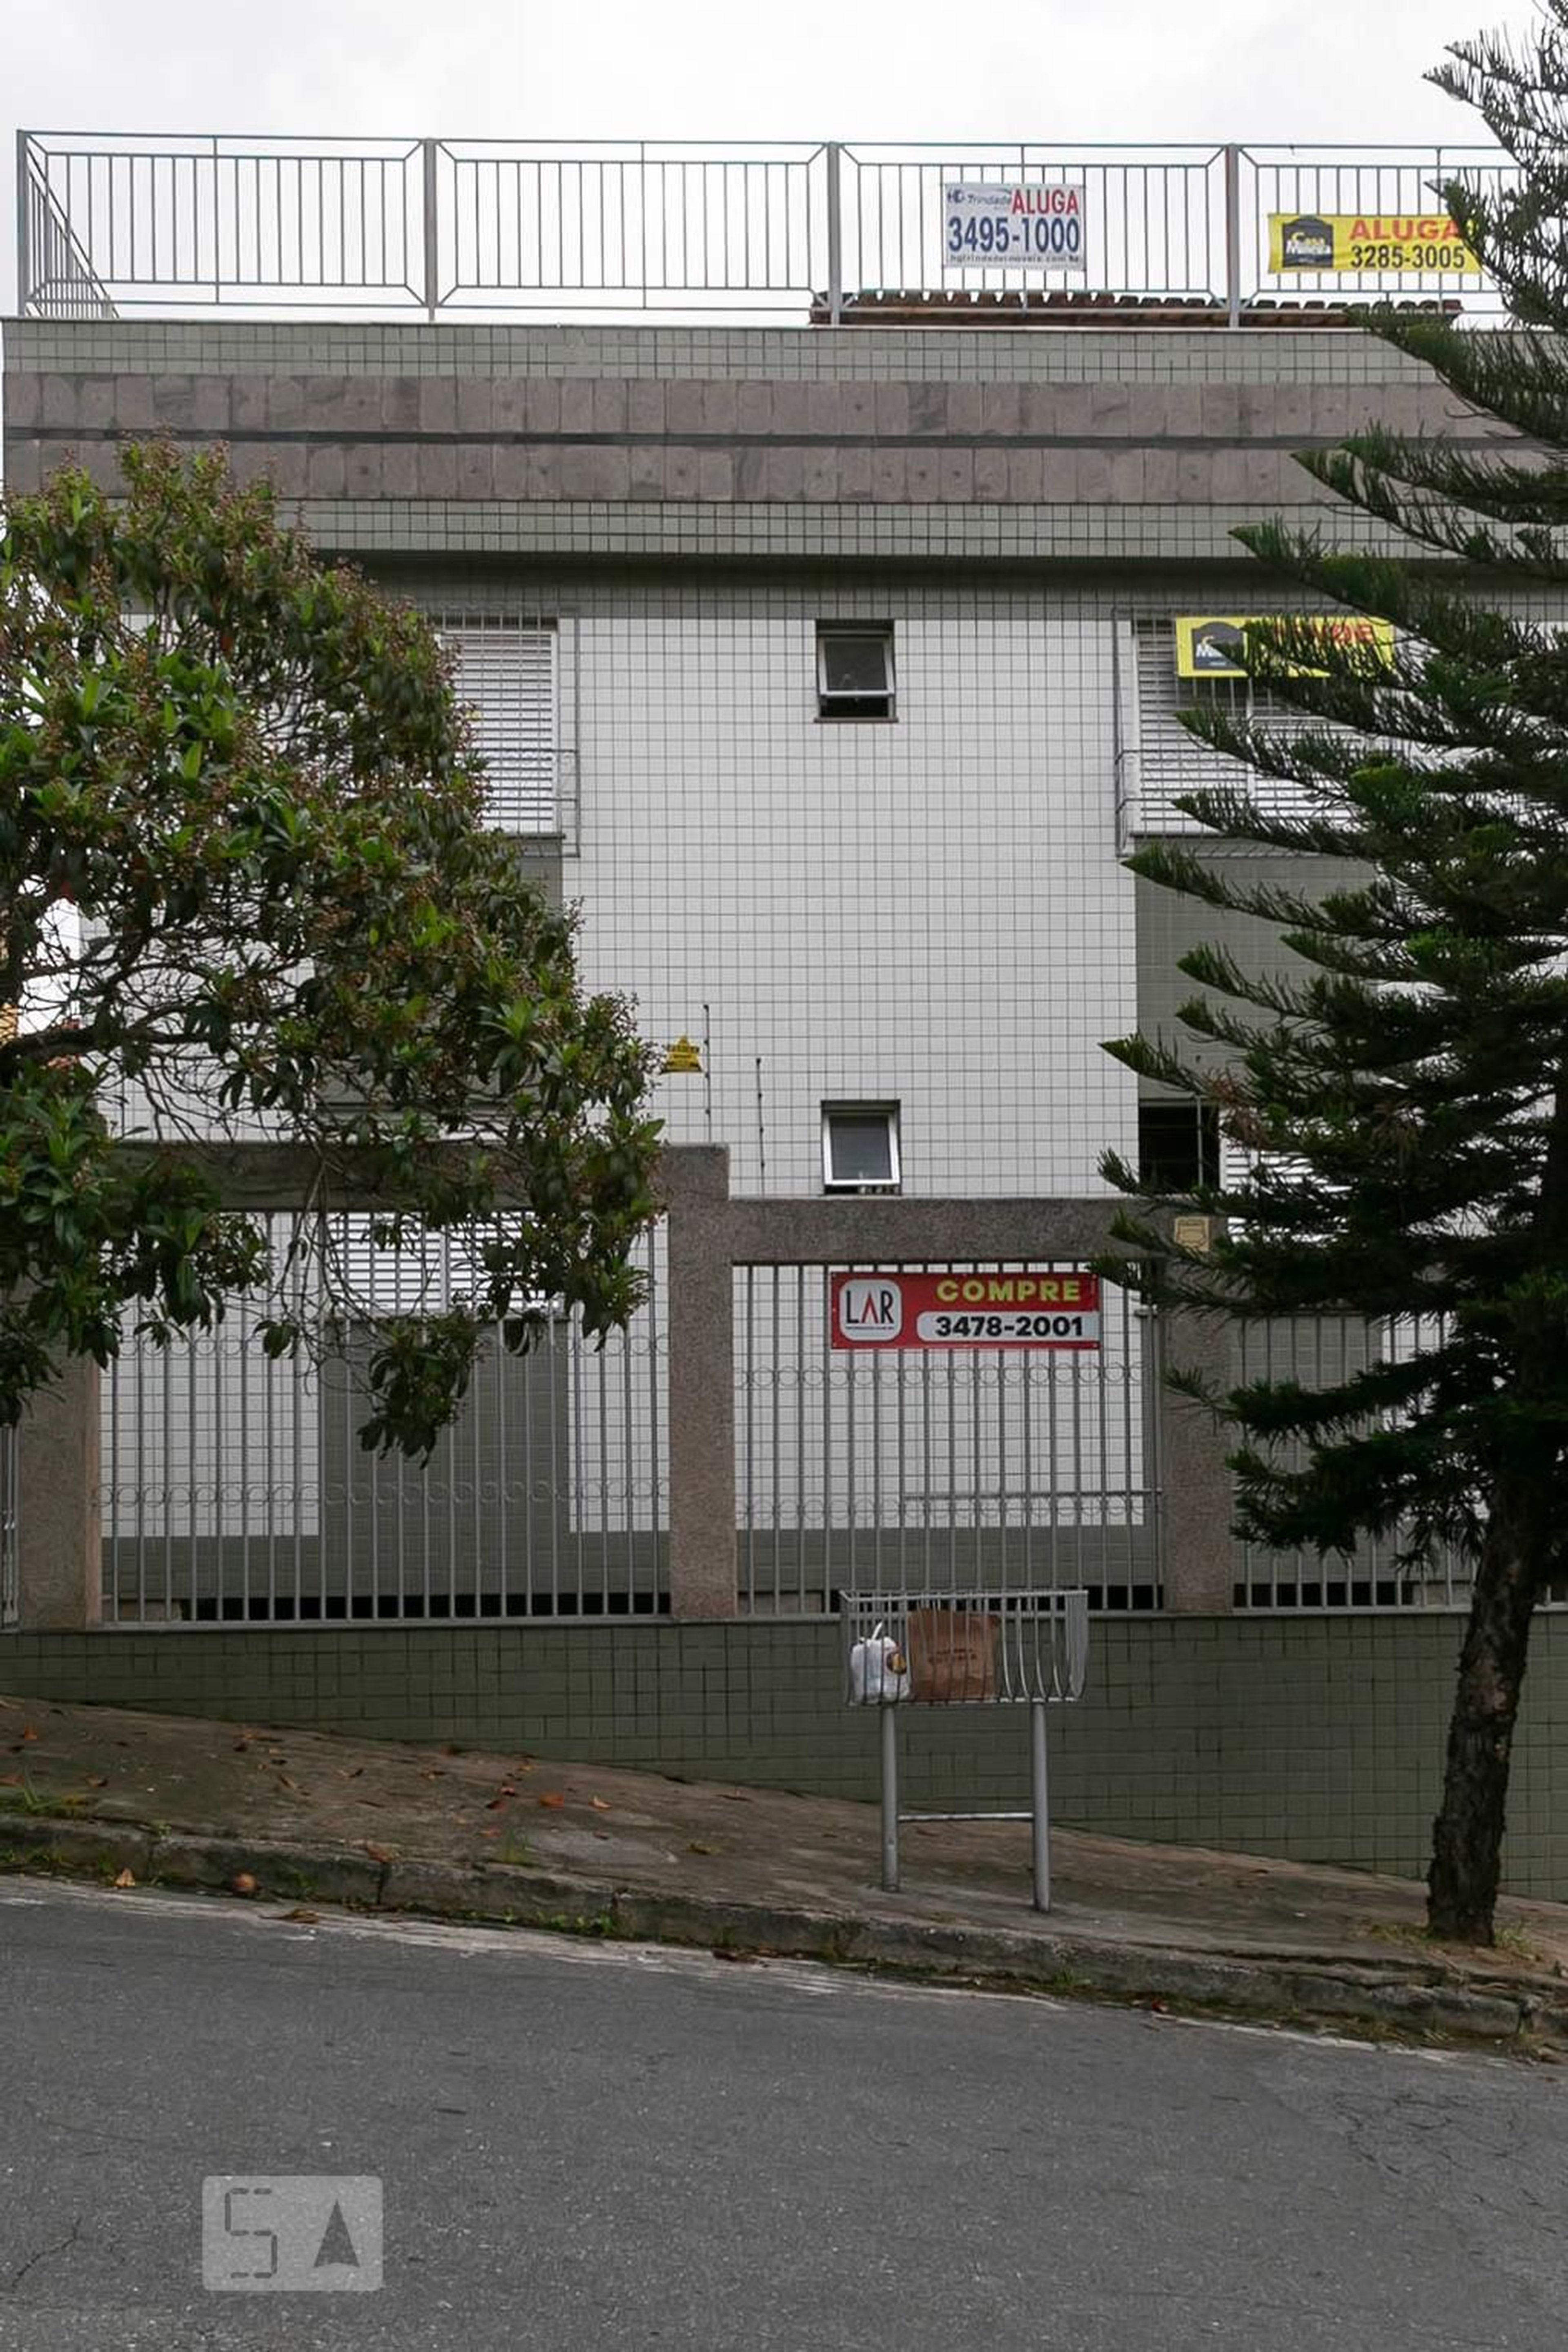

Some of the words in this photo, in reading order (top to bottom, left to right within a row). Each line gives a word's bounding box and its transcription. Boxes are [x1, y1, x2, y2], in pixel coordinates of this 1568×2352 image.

[1012, 189, 1079, 215] ALUGA
[948, 216, 1080, 253] 3495-1000
[1349, 219, 1461, 240] ALUGA
[1351, 245, 1465, 269] 3285-3005
[935, 1279, 1081, 1302] COMPRE
[846, 1289, 894, 1323] LAR
[935, 1316, 1083, 1337] 3478-2001
